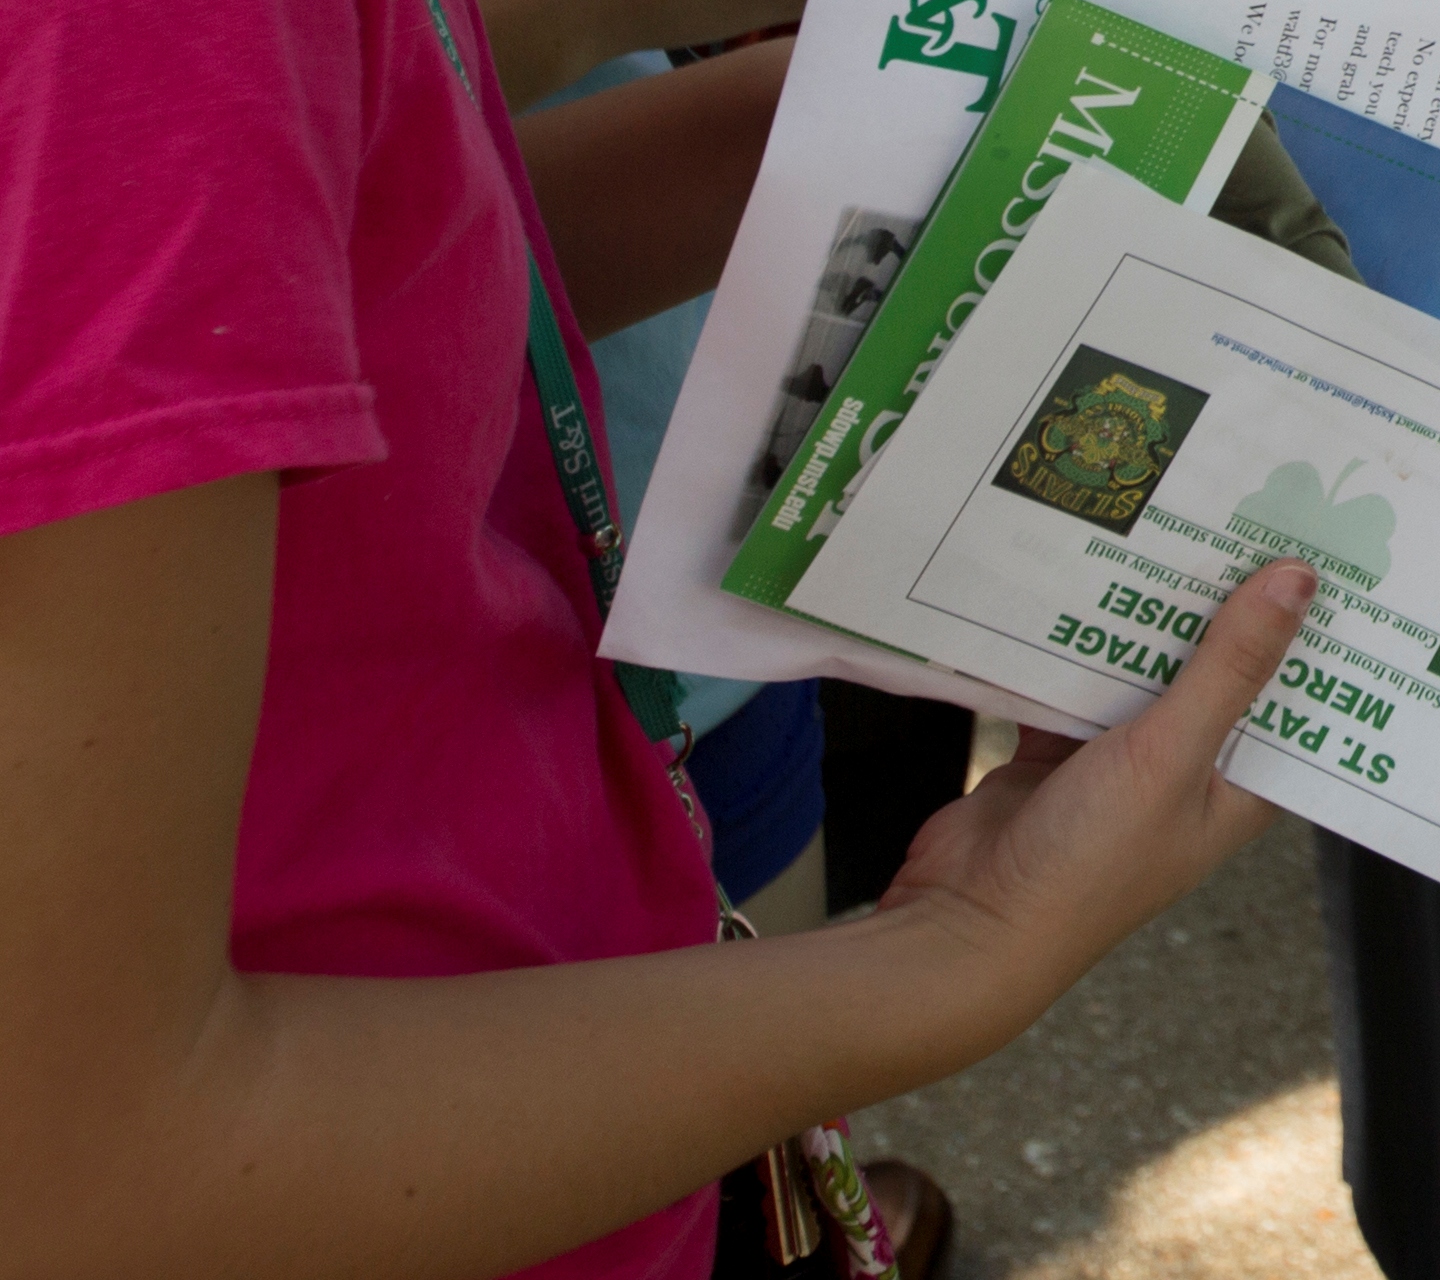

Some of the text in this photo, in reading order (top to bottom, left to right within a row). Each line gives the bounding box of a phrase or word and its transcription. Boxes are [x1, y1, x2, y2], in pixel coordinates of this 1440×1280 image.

[1336, 24, 1370, 101] and grab
[1363, 31, 1402, 116] teach you
[1330, 734, 1400, 785] ST.
